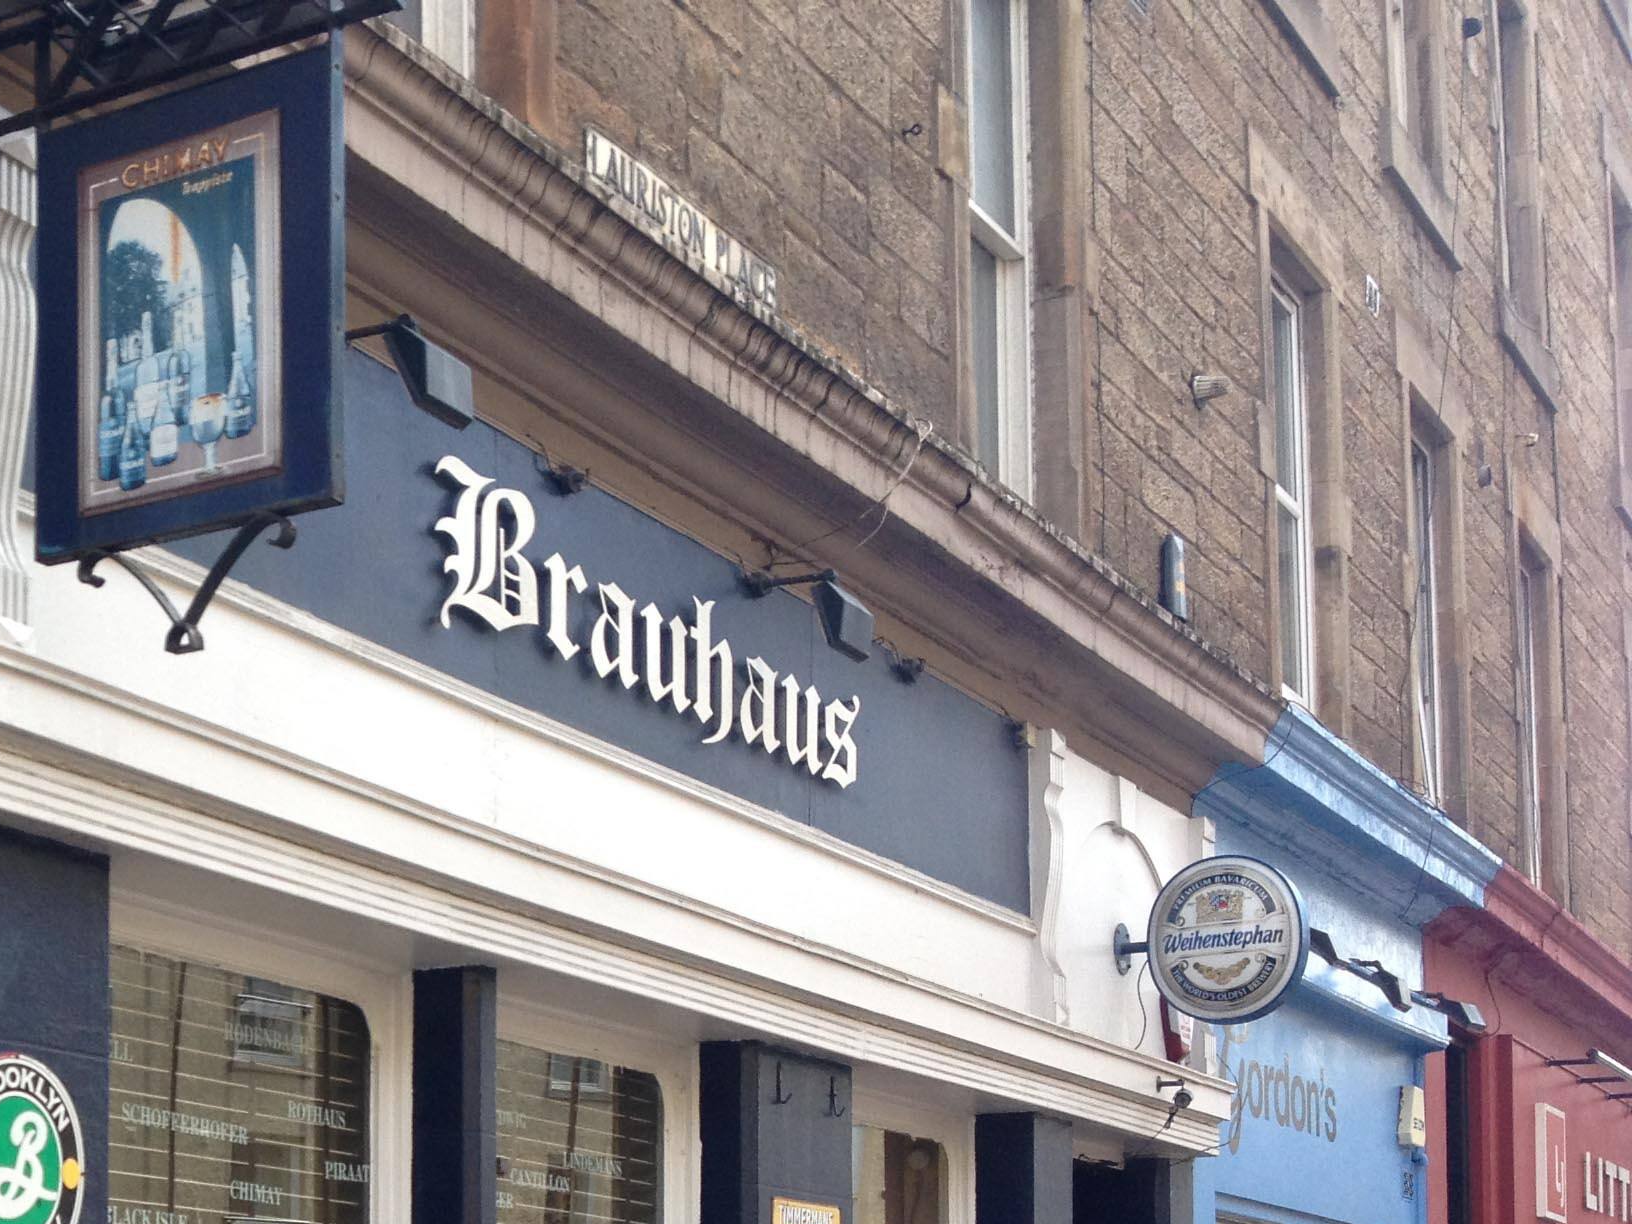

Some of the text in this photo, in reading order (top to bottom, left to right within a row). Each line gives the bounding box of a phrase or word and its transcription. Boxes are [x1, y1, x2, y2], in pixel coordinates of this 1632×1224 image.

[122, 137, 229, 187] CHIMAY
[591, 134, 706, 259] LAURISTON
[435, 455, 860, 789] Brauhaus
[1163, 925, 1283, 954] Weihenstephan
[288, 1100, 346, 1129] ROTHAUS
[324, 1160, 370, 1184] PIRAAT
[563, 1151, 623, 1178] LINDEMANS
[229, 1180, 283, 1206] CHIMAY
[510, 1168, 570, 1192] CANTILLON
